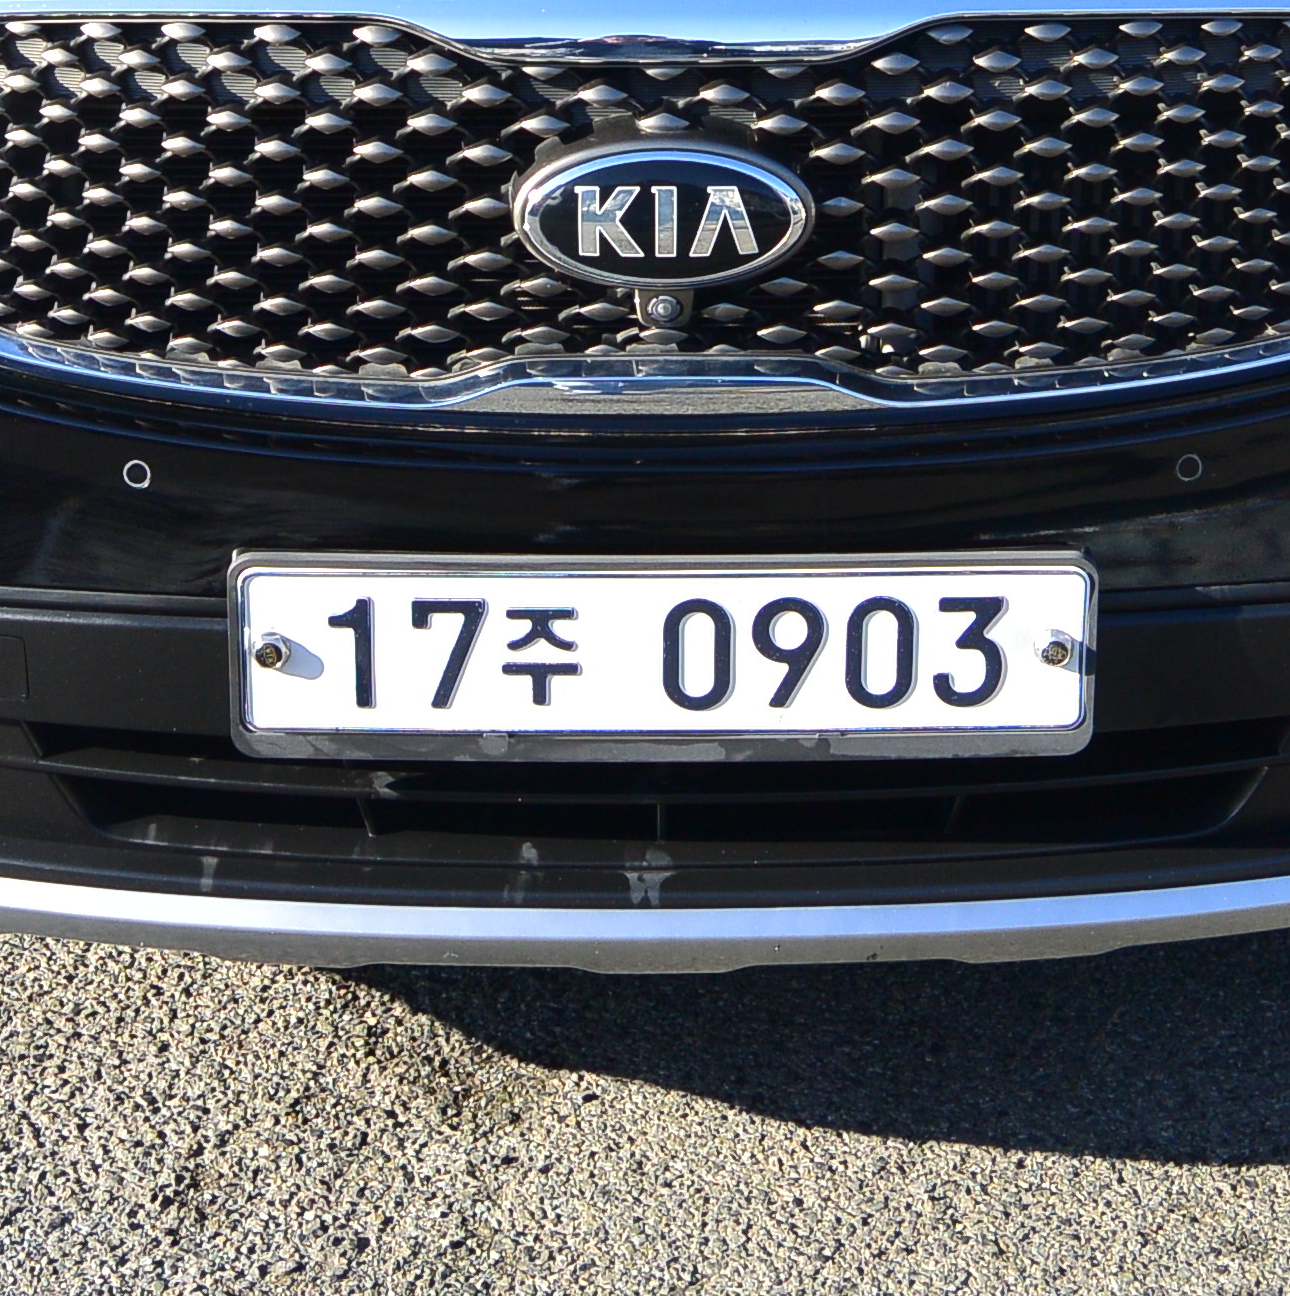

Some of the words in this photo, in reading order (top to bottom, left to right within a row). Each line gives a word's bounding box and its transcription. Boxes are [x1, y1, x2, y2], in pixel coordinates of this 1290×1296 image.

[574, 185, 759, 258] KIA
[327, 595, 580, 709] 17주
[661, 595, 1009, 711] 0903
